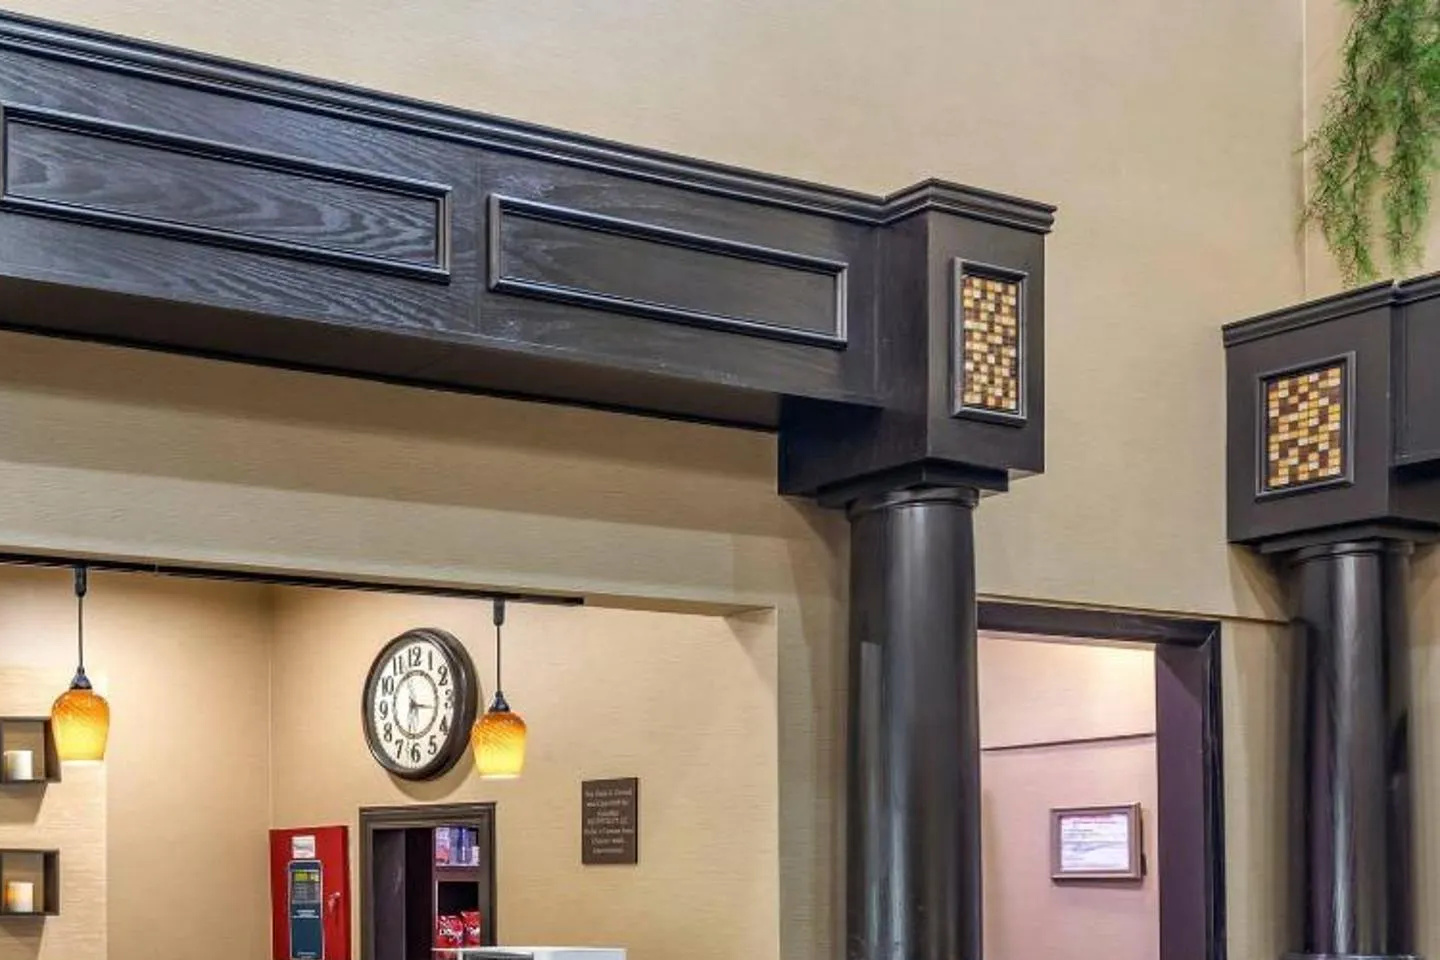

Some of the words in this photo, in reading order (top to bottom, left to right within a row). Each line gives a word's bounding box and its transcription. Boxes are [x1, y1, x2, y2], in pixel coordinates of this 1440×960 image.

[393, 656, 404, 676] 11
[408, 647, 422, 667] 12
[438, 665, 448, 685] 2
[382, 676, 394, 696] 10
[380, 701, 389, 720] 9
[384, 724, 393, 742] 8
[395, 739, 404, 759] 7
[411, 743, 421, 763] 6
[428, 735, 438, 755] 5
